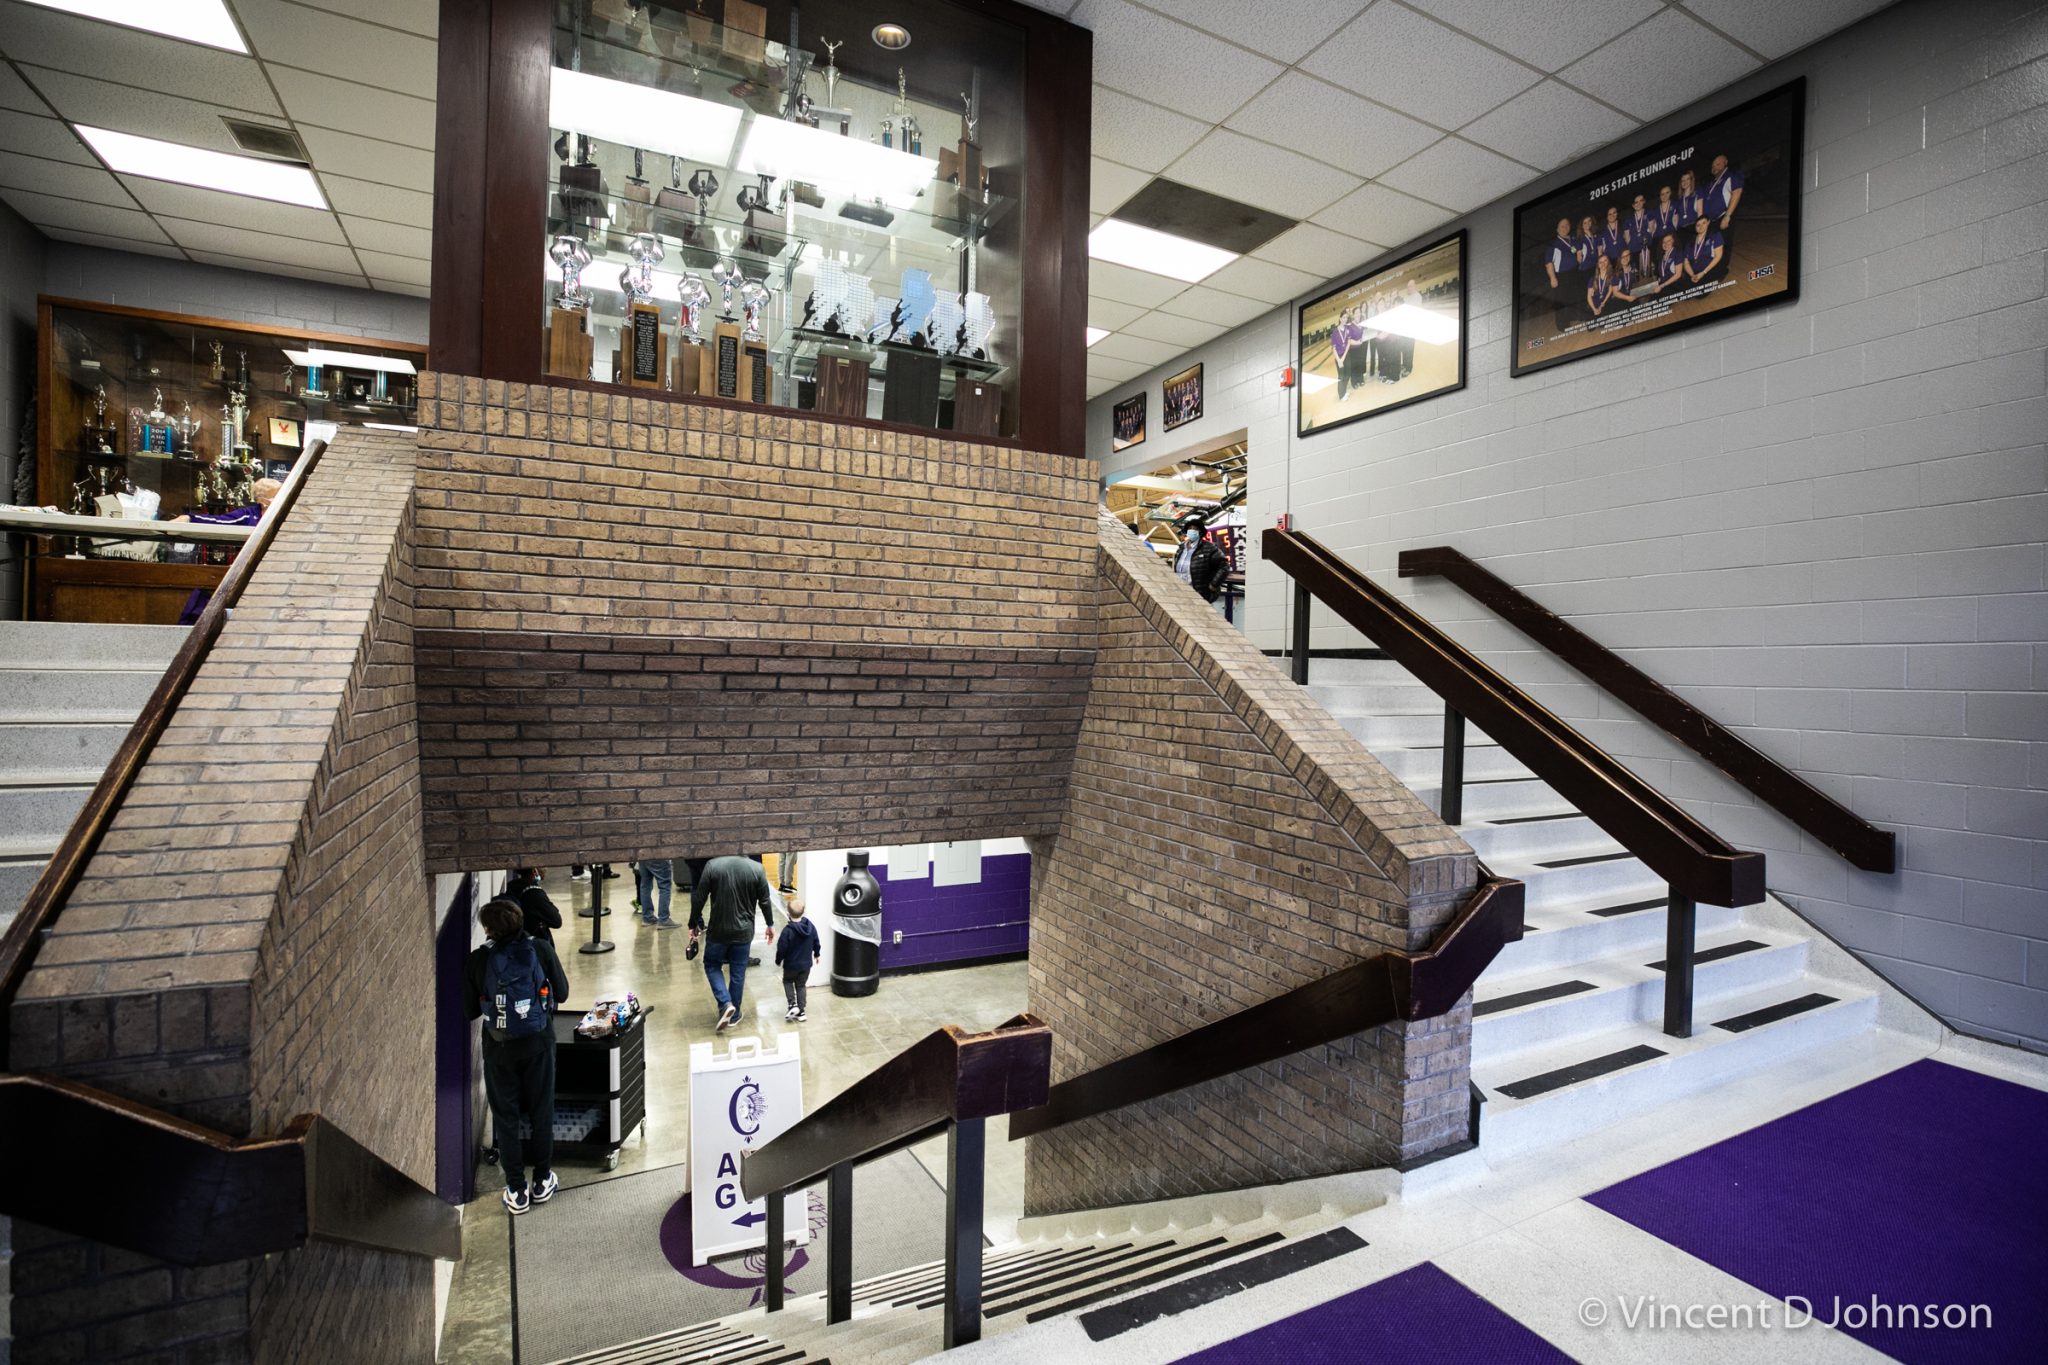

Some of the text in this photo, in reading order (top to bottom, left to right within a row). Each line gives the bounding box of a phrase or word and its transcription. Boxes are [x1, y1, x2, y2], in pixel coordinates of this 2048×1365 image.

[1589, 147, 1695, 201] 2015 STATE RUNNER-UP
[1223, 535, 1231, 548] 5
